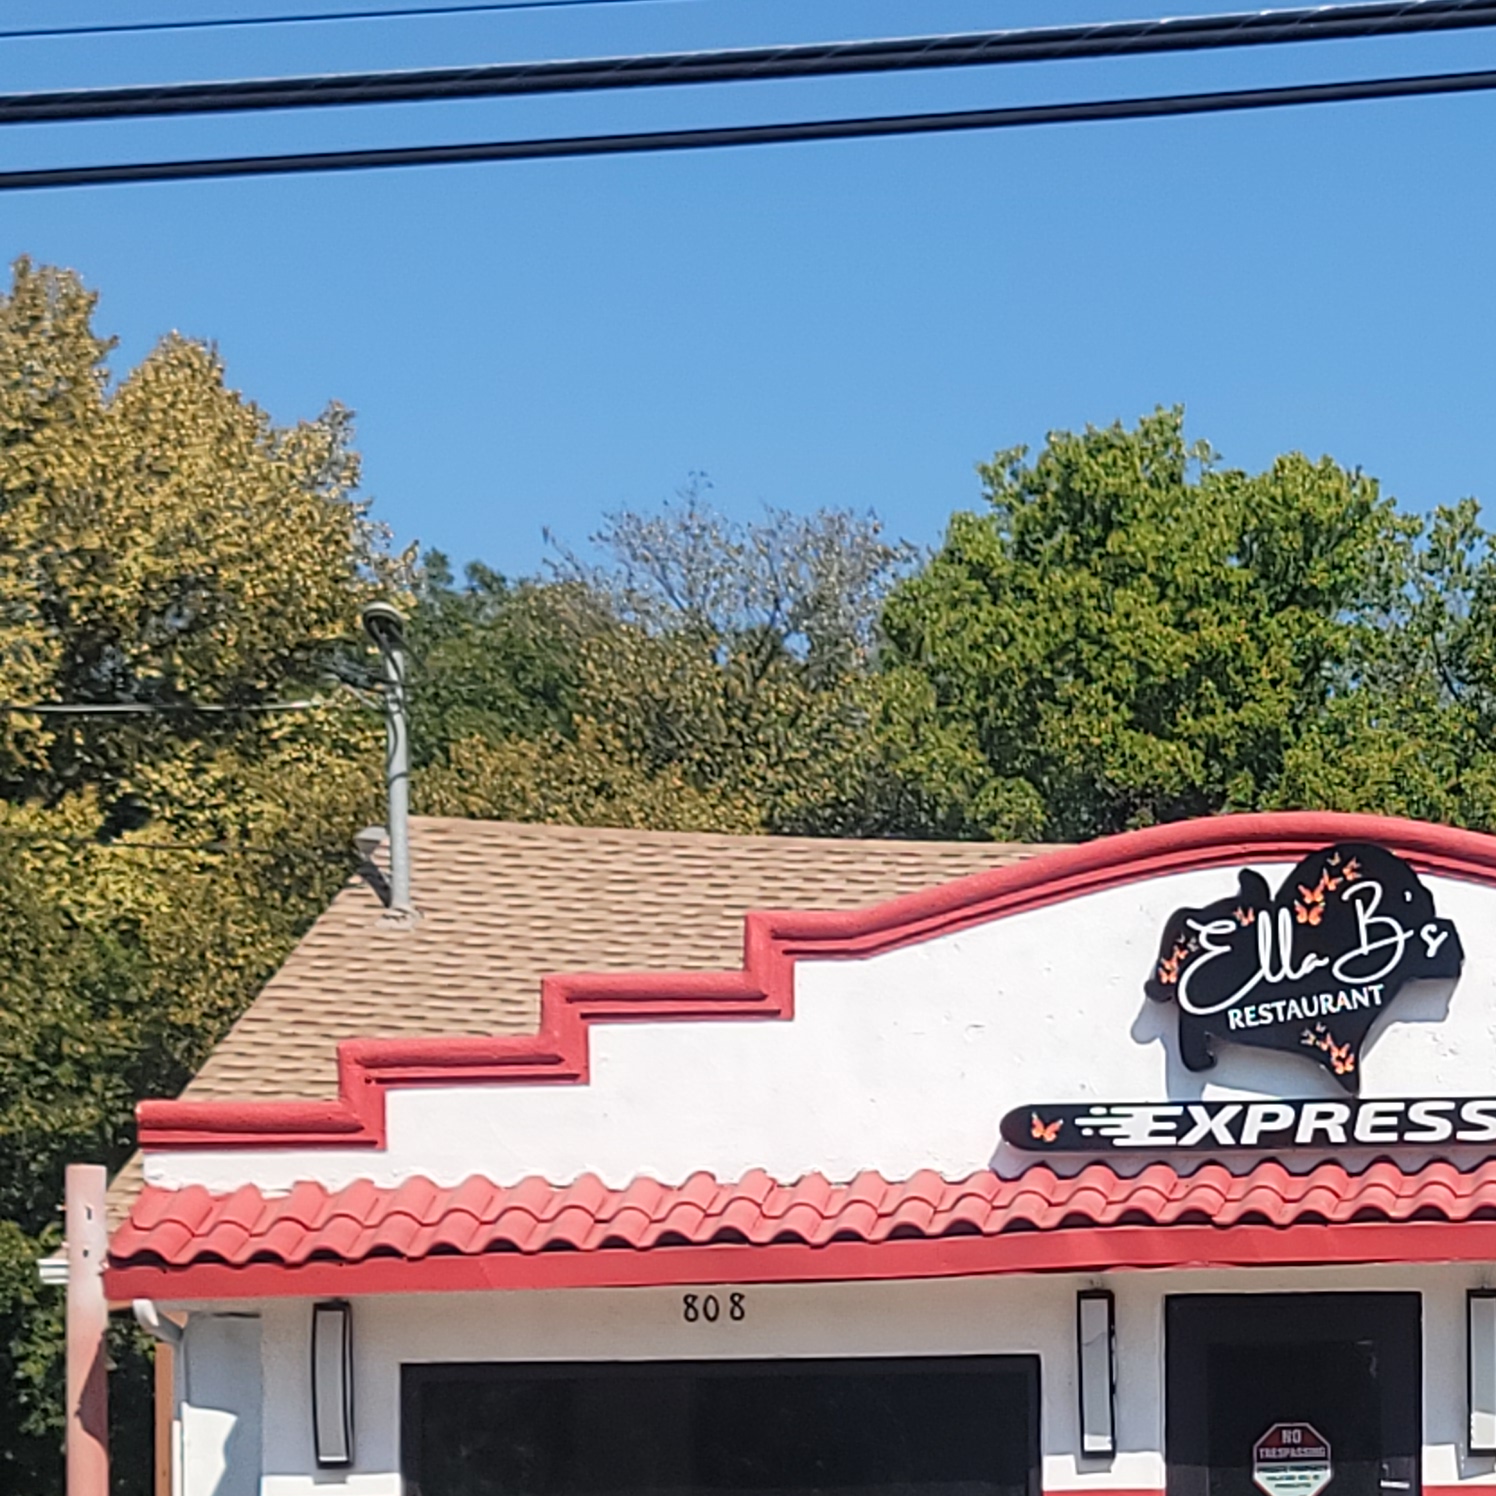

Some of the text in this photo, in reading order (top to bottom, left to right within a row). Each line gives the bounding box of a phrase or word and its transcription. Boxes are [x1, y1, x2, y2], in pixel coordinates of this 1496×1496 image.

[1177, 881, 1448, 1015] Ella B's
[1227, 984, 1386, 1030] RESTAURANT
[682, 1292, 746, 1323] 808
[1281, 1429, 1302, 1444] NO
[1259, 1446, 1326, 1459] TRESPASSING
